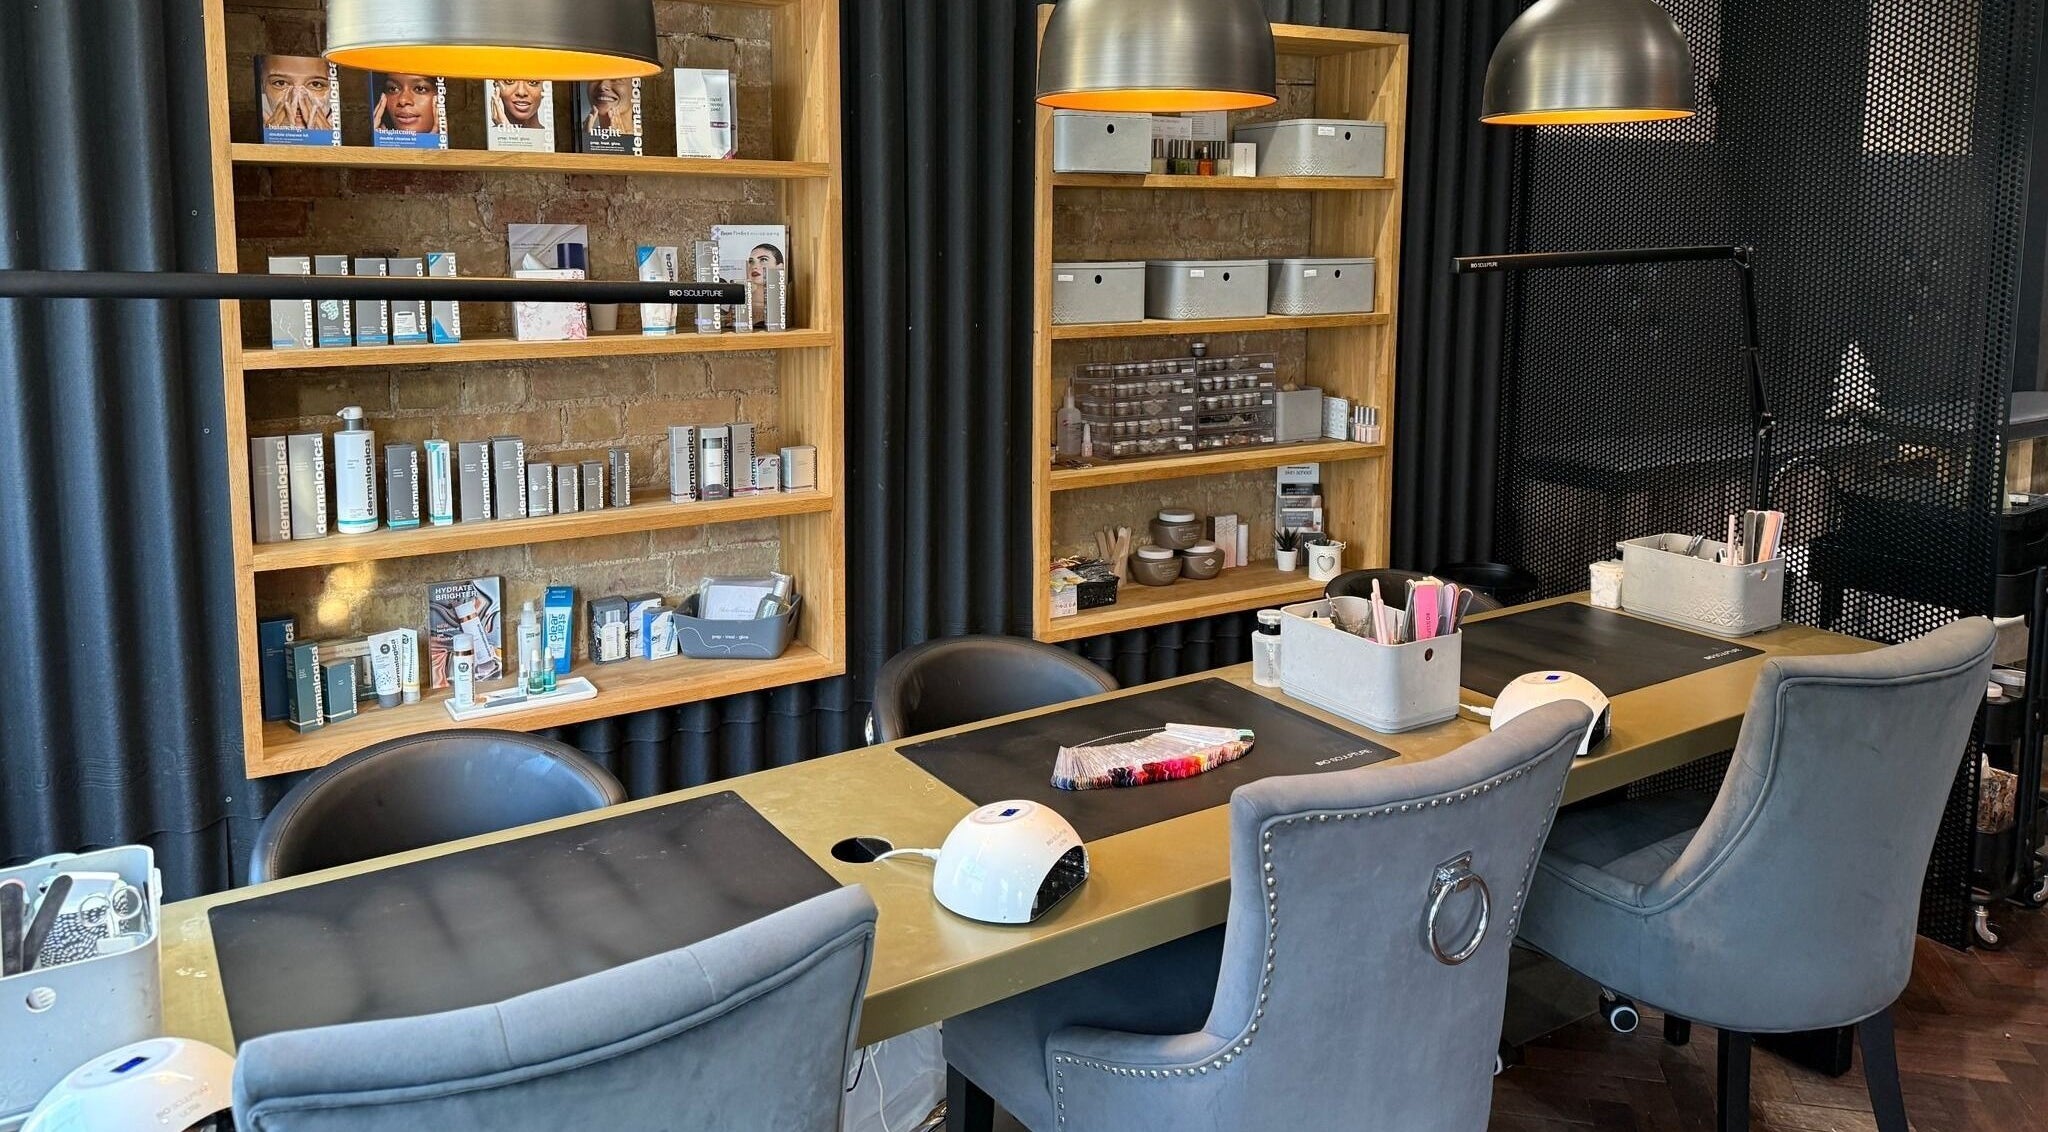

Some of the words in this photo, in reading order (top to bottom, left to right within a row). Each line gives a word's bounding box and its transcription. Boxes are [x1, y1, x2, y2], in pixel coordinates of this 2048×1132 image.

[379, 128, 417, 136] brightening
[436, 76, 448, 149] dermalogic
[541, 81, 554, 152] dermalo
[590, 125, 622, 140] night
[631, 77, 643, 156] dermalog
[669, 289, 682, 297] BIO
[683, 289, 724, 297] SCULPTURE
[778, 270, 786, 330] dermalogica
[276, 440, 291, 540] dermalogica
[313, 437, 327, 534] dermalogica
[364, 439, 374, 516] dermalogica
[410, 450, 420, 518] dermalogica
[480, 445, 491, 519] dermalogica
[516, 442, 527, 516] dermalogica
[687, 428, 696, 499] dermalogica
[435, 585, 473, 595] HYDRATE
[435, 590, 478, 601] BRIGHTER
[549, 614, 558, 642] clear
[557, 613, 566, 641] start
[311, 646, 324, 726] dermalogica
